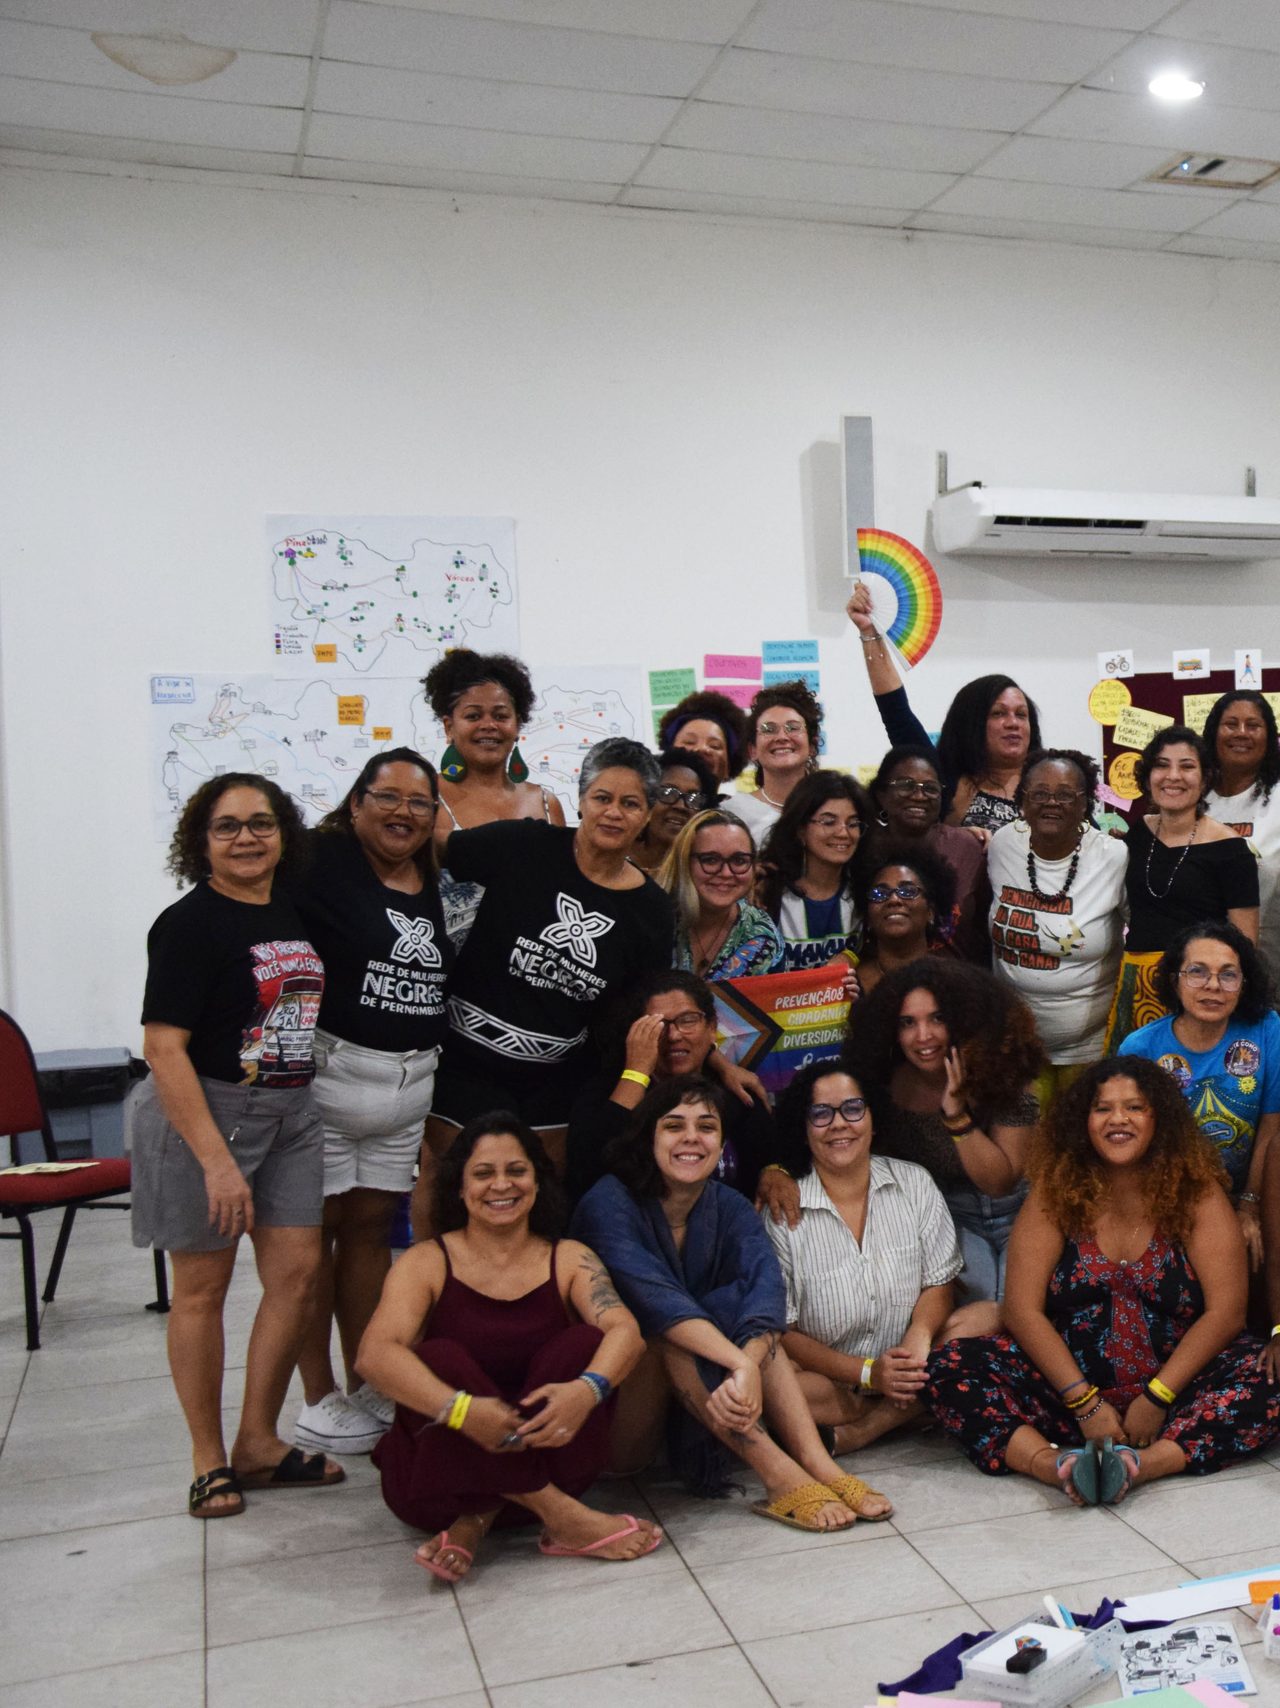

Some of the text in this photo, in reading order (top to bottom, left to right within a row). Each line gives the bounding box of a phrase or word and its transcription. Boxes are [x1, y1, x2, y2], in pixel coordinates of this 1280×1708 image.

[252, 960, 282, 982] VOCÊ
[367, 960, 396, 975] REDE
[397, 967, 410, 978] DE
[516, 936, 607, 988] REDE DE MULHERES
[360, 995, 378, 1008] DE
[783, 1028, 847, 1049] DIVERSIDA
